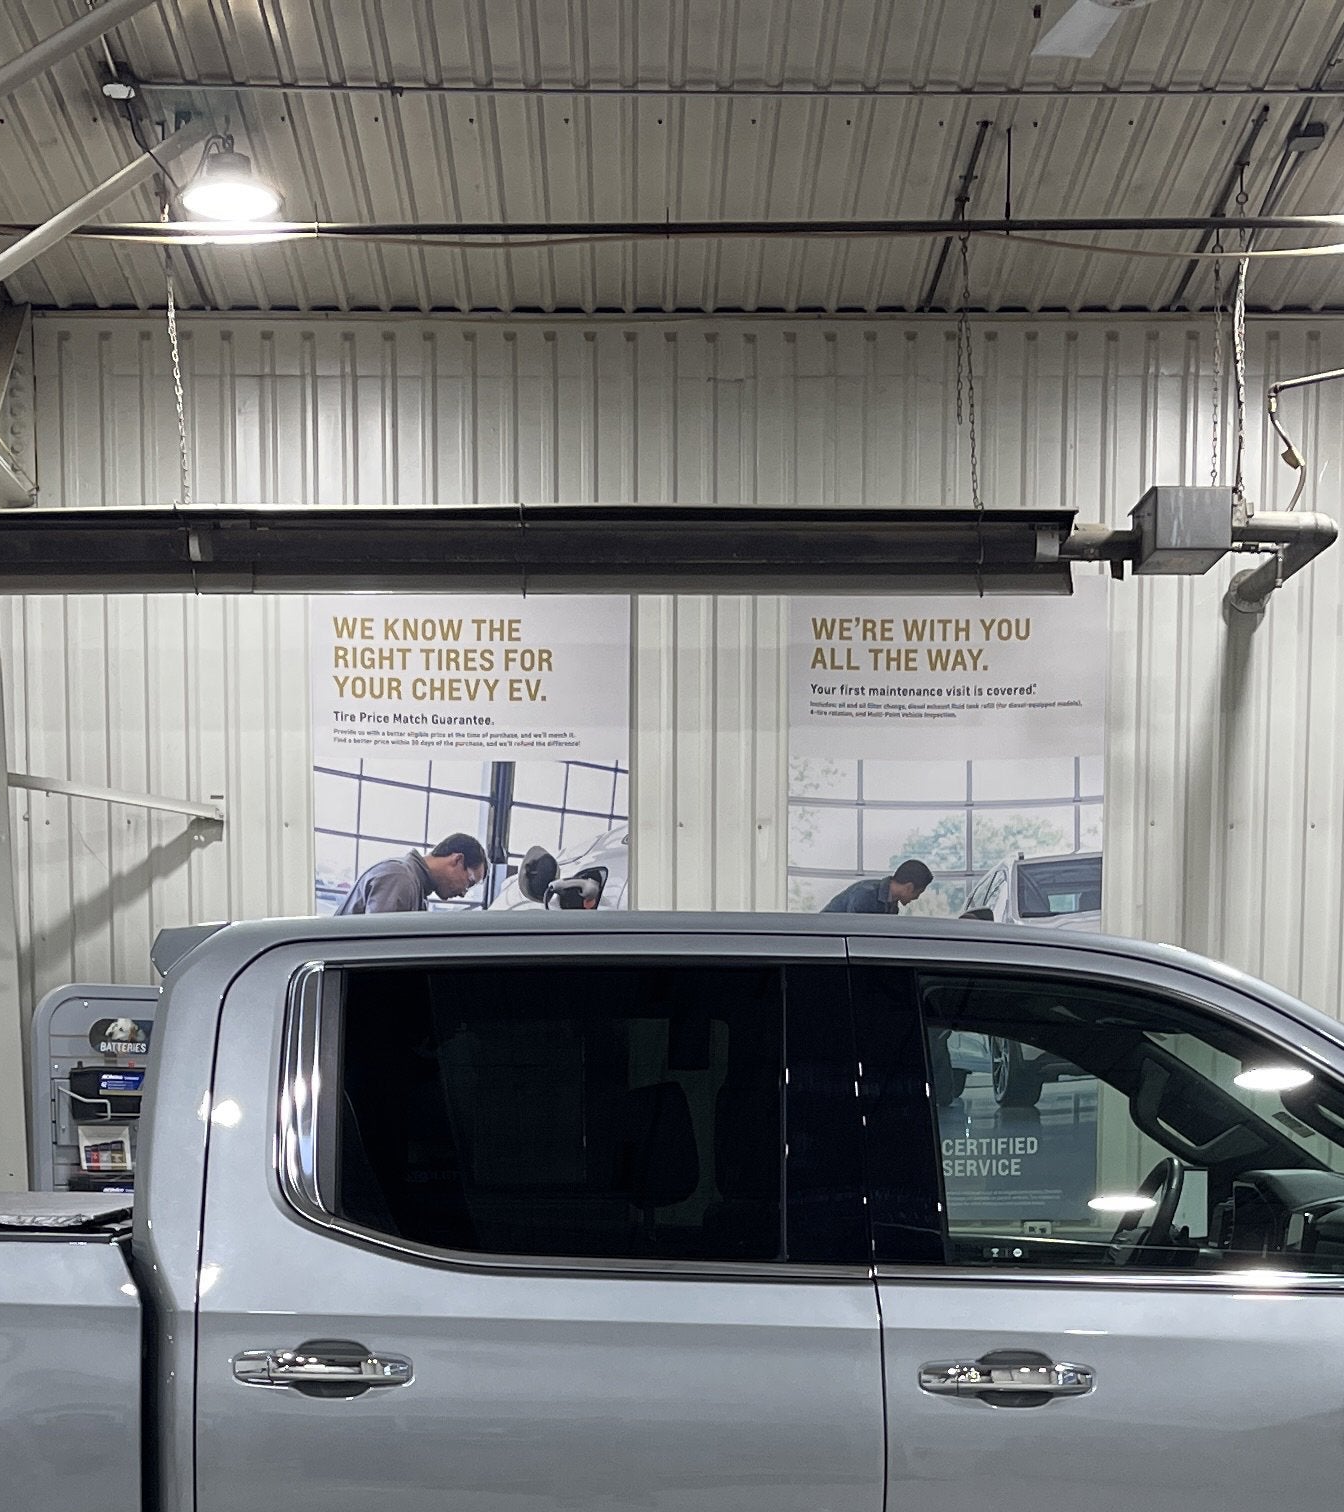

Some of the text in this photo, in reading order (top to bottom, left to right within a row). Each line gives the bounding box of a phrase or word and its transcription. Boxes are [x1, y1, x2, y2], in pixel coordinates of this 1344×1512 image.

[333, 616, 522, 641] WE KNOW THE
[811, 617, 1031, 641] WE'RE WITH YOU
[334, 646, 553, 672] RIGHT TIRES FOR
[810, 647, 989, 671] ALL THE WAY.
[333, 675, 546, 701] YOUR CHEVY EV.
[810, 684, 836, 695] Your
[840, 684, 866, 696] first
[868, 685, 942, 697] maintenance
[946, 685, 971, 697] visit
[974, 685, 983, 697] is
[333, 711, 495, 726] Tire Price Match Guarantee.
[100, 1041, 147, 1053] BATTERIES
[941, 1137, 1038, 1155] CERTIFIED
[942, 1158, 1022, 1177] SERVICE
